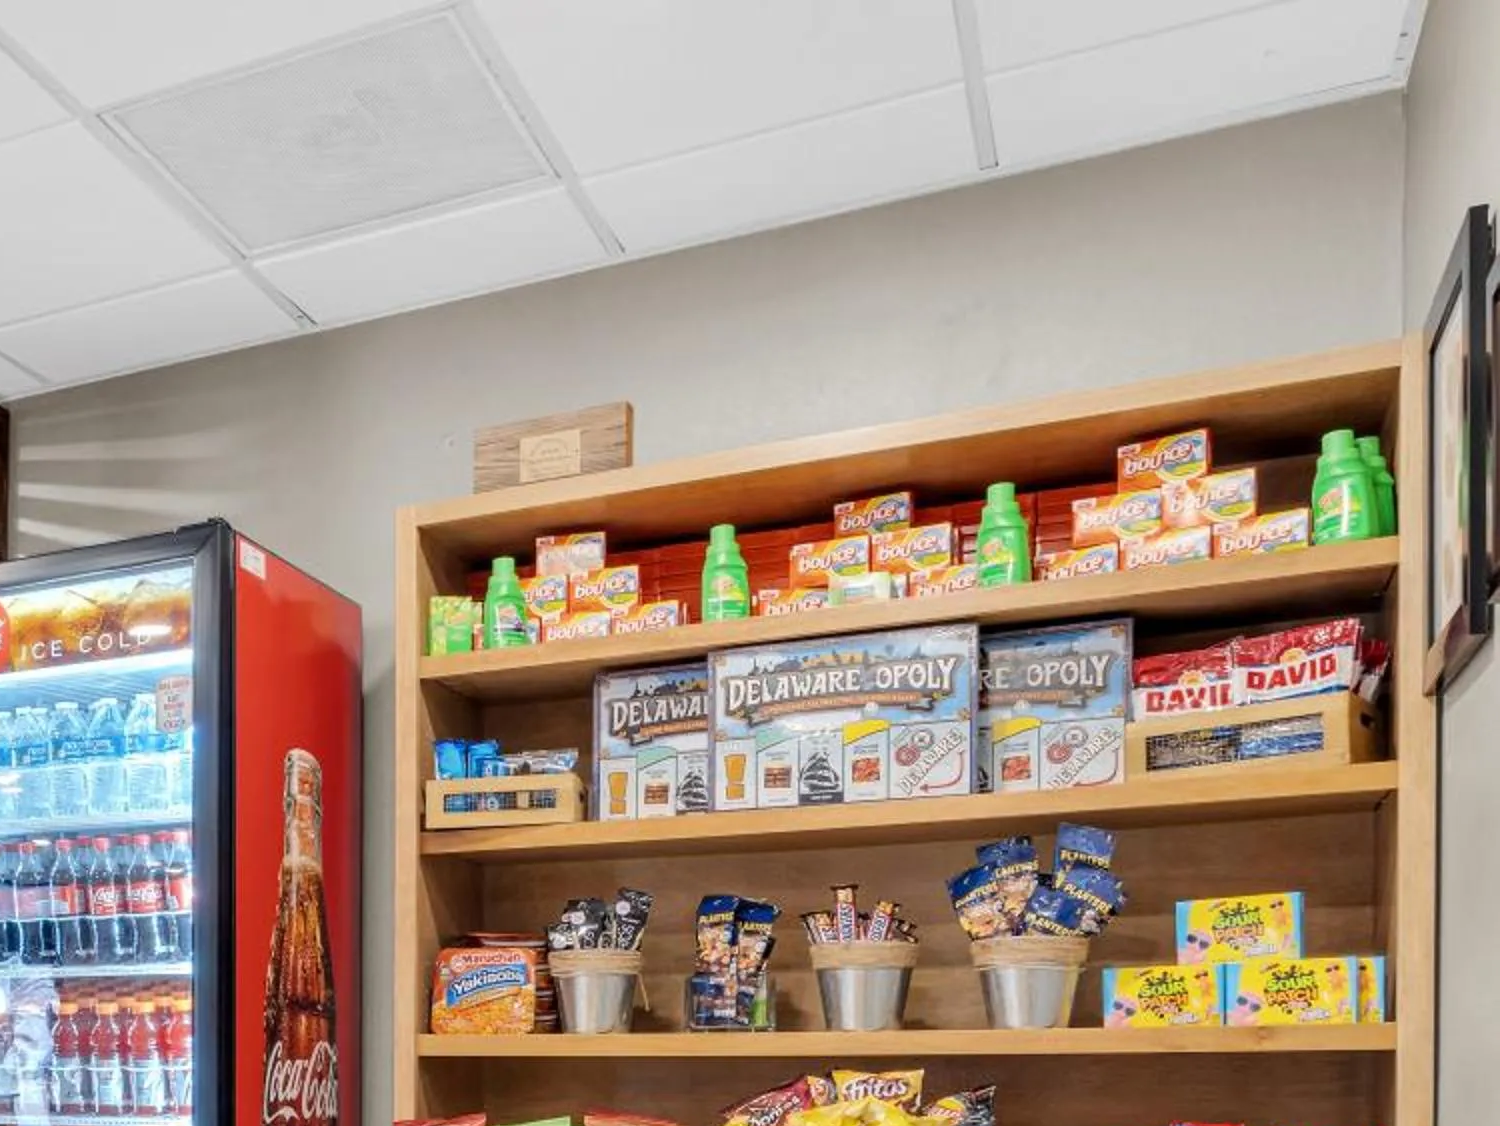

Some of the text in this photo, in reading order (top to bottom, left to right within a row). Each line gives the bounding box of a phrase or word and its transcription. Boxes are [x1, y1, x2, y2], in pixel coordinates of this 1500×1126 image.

[1125, 442, 1191, 477] bounce
[840, 504, 898, 532] bounce
[1080, 500, 1146, 528] bounce
[879, 534, 938, 561] bounce
[1221, 522, 1293, 552] bounce
[799, 547, 856, 573] bounce
[575, 575, 629, 599] bounce
[19, 631, 152, 661] ICE COLD
[727, 667, 861, 710] DELAWARE
[875, 657, 957, 690] OPOLY
[1027, 655, 1111, 689] OPOLY
[1246, 652, 1337, 690] DAVID
[612, 695, 708, 727] DELAWA
[1217, 911, 1260, 929] SOUR
[1213, 924, 1265, 944] PATCH
[462, 951, 523, 964] Maruchan
[1139, 980, 1186, 997] SOUR
[1267, 975, 1315, 991] SOUR
[1139, 993, 1189, 1012] PATCH
[1266, 988, 1319, 1006] PATCH
